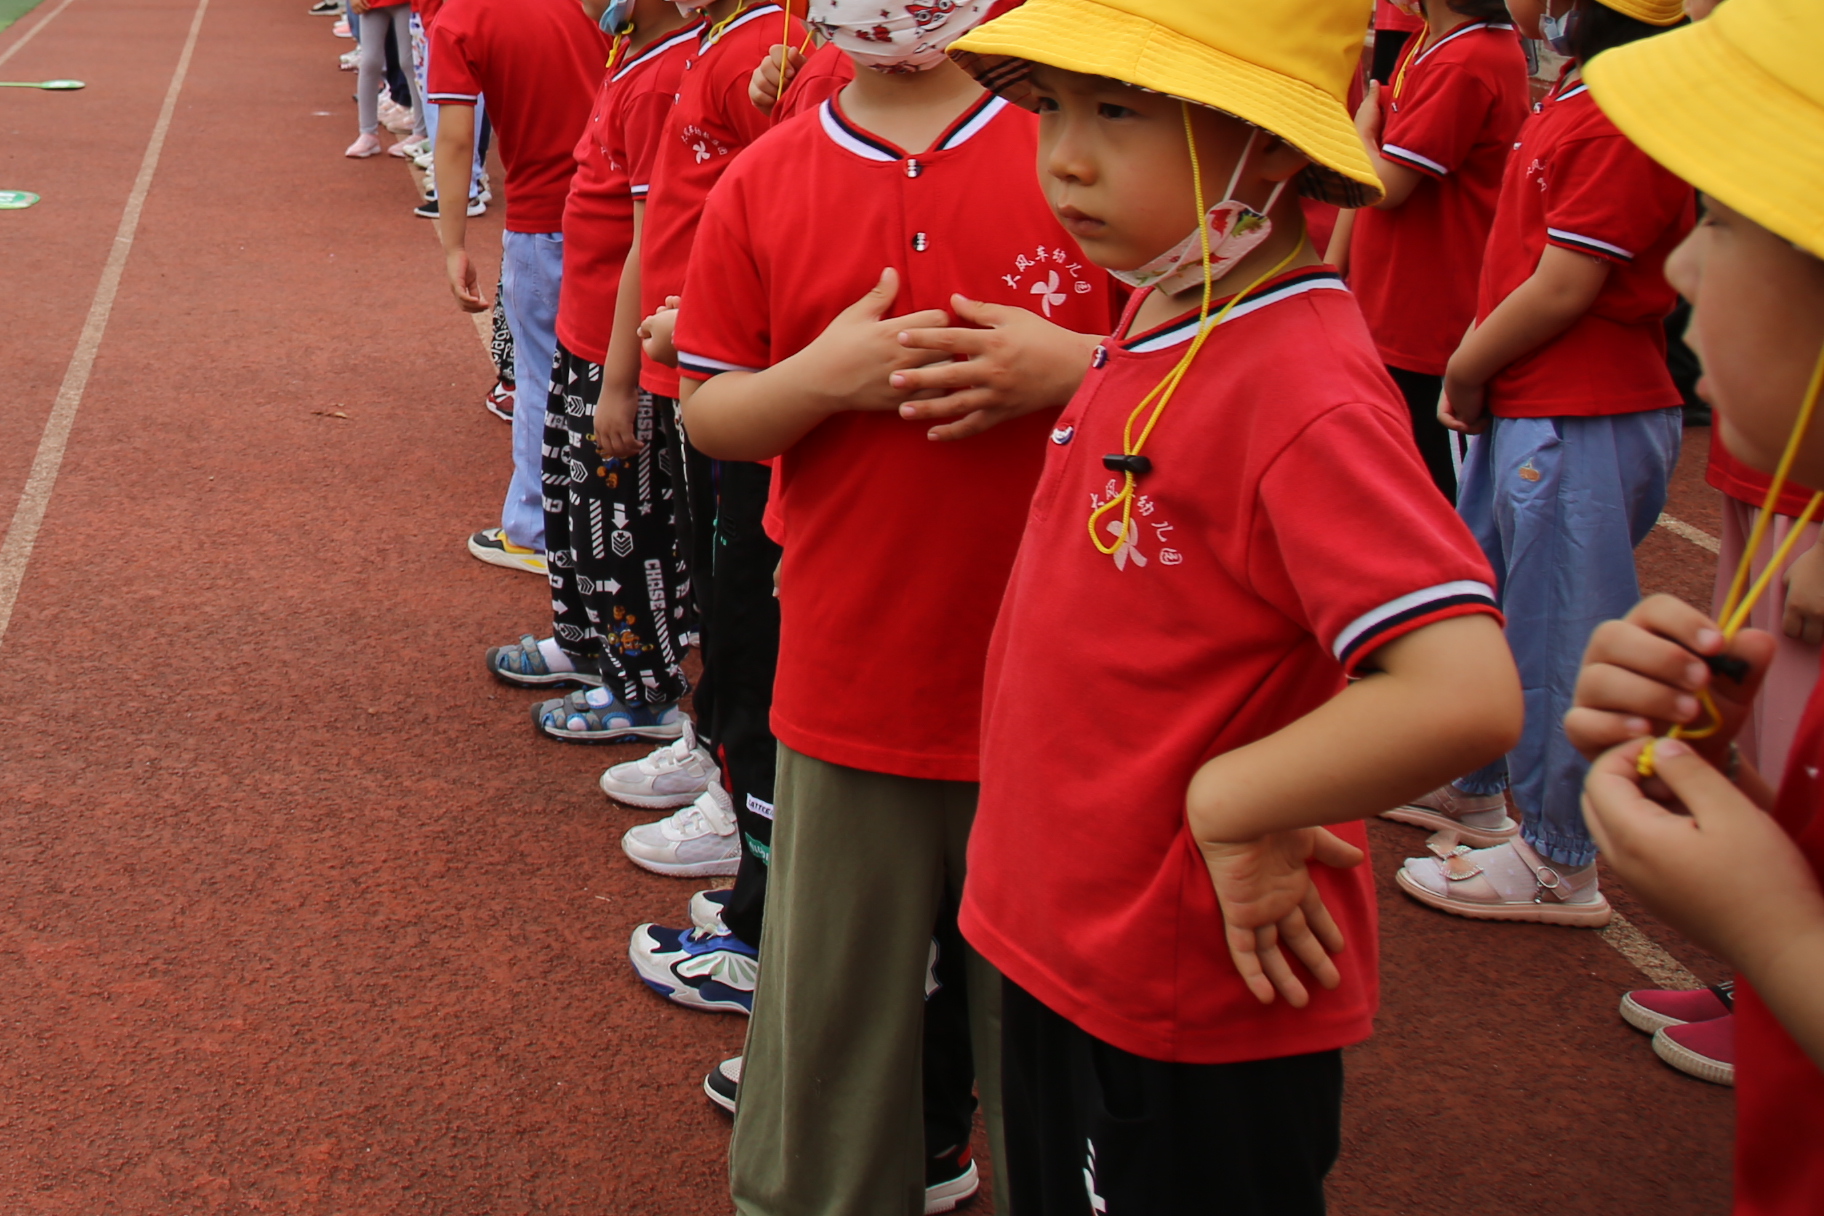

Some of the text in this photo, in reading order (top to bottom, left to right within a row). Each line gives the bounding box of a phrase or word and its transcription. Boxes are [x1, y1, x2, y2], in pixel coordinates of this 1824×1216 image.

[1001, 245, 1092, 290] 大风车幼儿园
[1090, 478, 1183, 565] 大风幼儿园
[644, 559, 666, 611] CHASE
